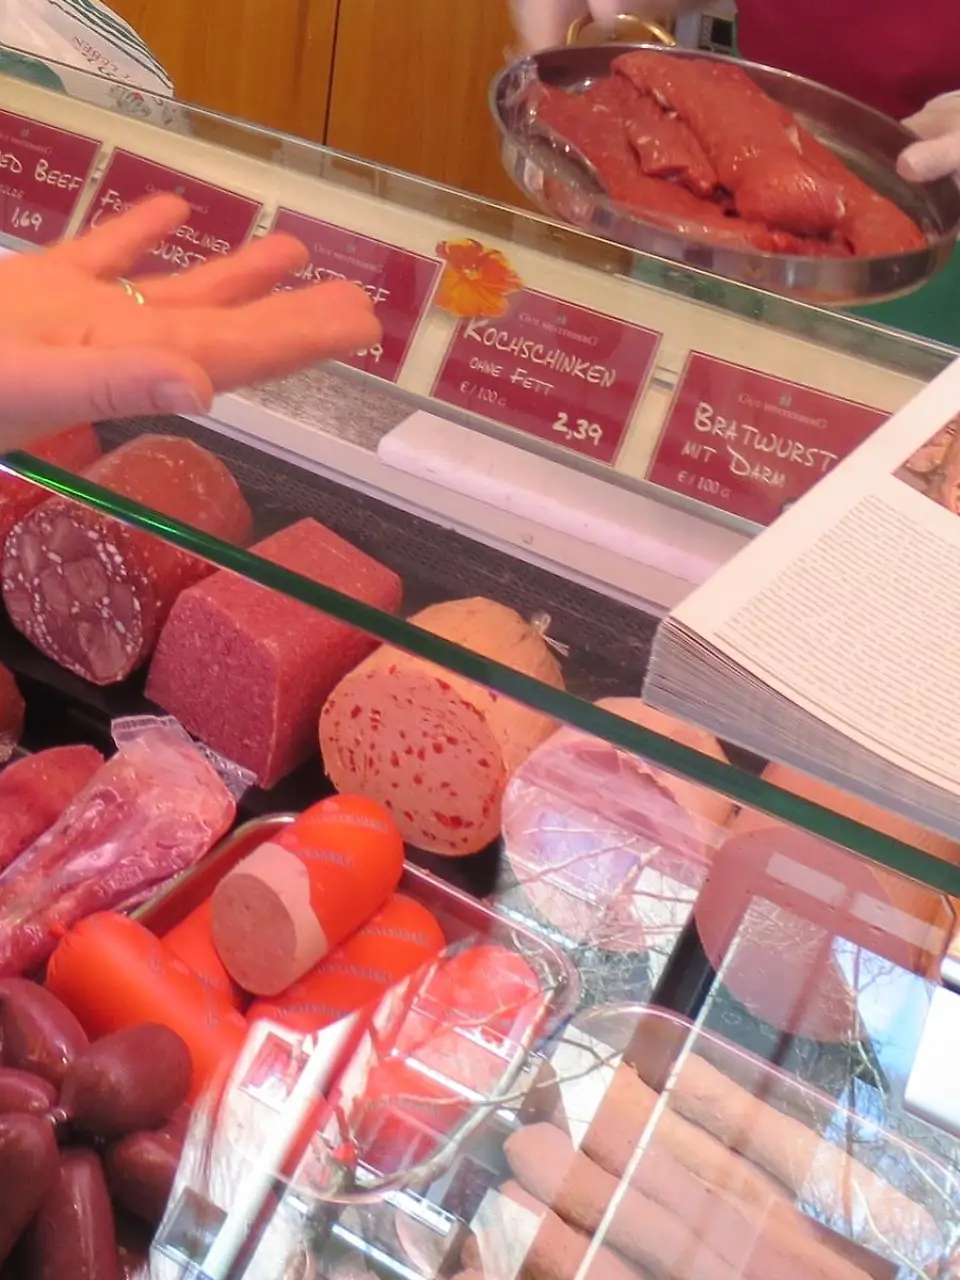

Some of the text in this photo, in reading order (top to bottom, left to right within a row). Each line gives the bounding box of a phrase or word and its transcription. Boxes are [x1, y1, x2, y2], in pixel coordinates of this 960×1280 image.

[34, 158, 84, 192] BEEF
[11, 206, 43, 232] 1,69
[170, 224, 231, 255] ERLINER
[464, 318, 617, 388] KOCHSCHINKEN
[469, 357, 556, 396] OHNE FETT
[552, 411, 604, 446] 2,39
[693, 401, 839, 472] BRATWURST
[680, 441, 786, 489] MIT DARM
